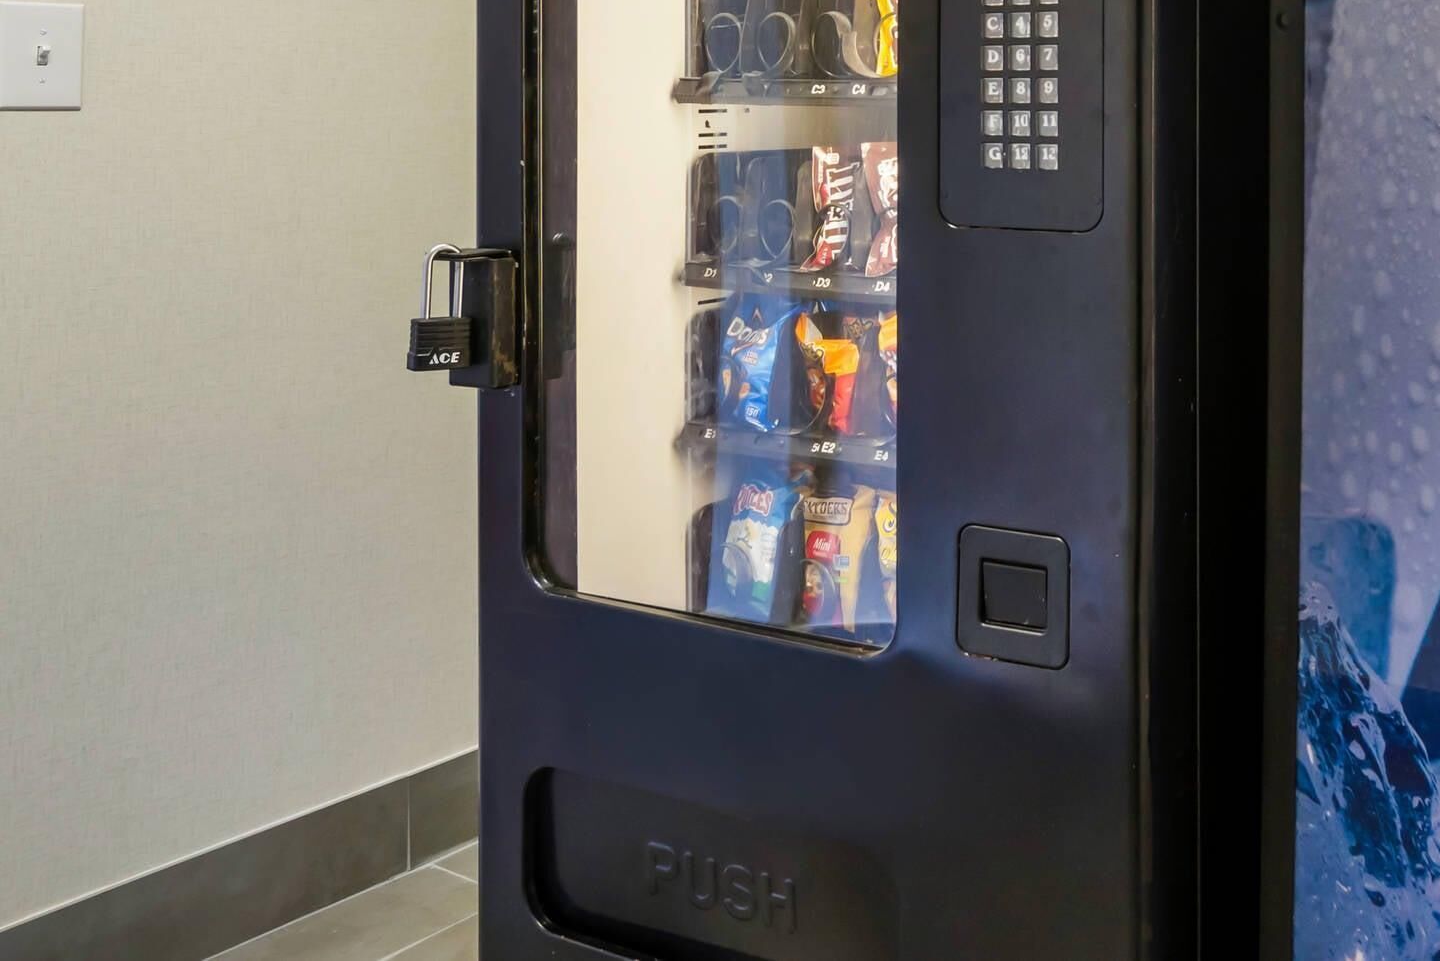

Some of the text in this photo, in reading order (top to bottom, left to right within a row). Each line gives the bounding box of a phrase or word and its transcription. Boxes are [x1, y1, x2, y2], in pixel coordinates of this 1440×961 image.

[986, 14, 1052, 31] C 4 5
[987, 48, 1053, 63] D 6 7
[811, 84, 826, 94] C3
[852, 84, 866, 94] C4
[988, 81, 1054, 95] E 8 9
[988, 114, 1057, 128] F 10 11
[988, 147, 1002, 160] G
[704, 268, 717, 278] D1
[815, 277, 831, 288] D3
[874, 280, 890, 292] D4
[429, 351, 461, 365] ACE
[820, 441, 836, 454] E2
[874, 450, 889, 461] E4
[813, 537, 832, 552] Mini
[648, 841, 796, 935] PUSH
